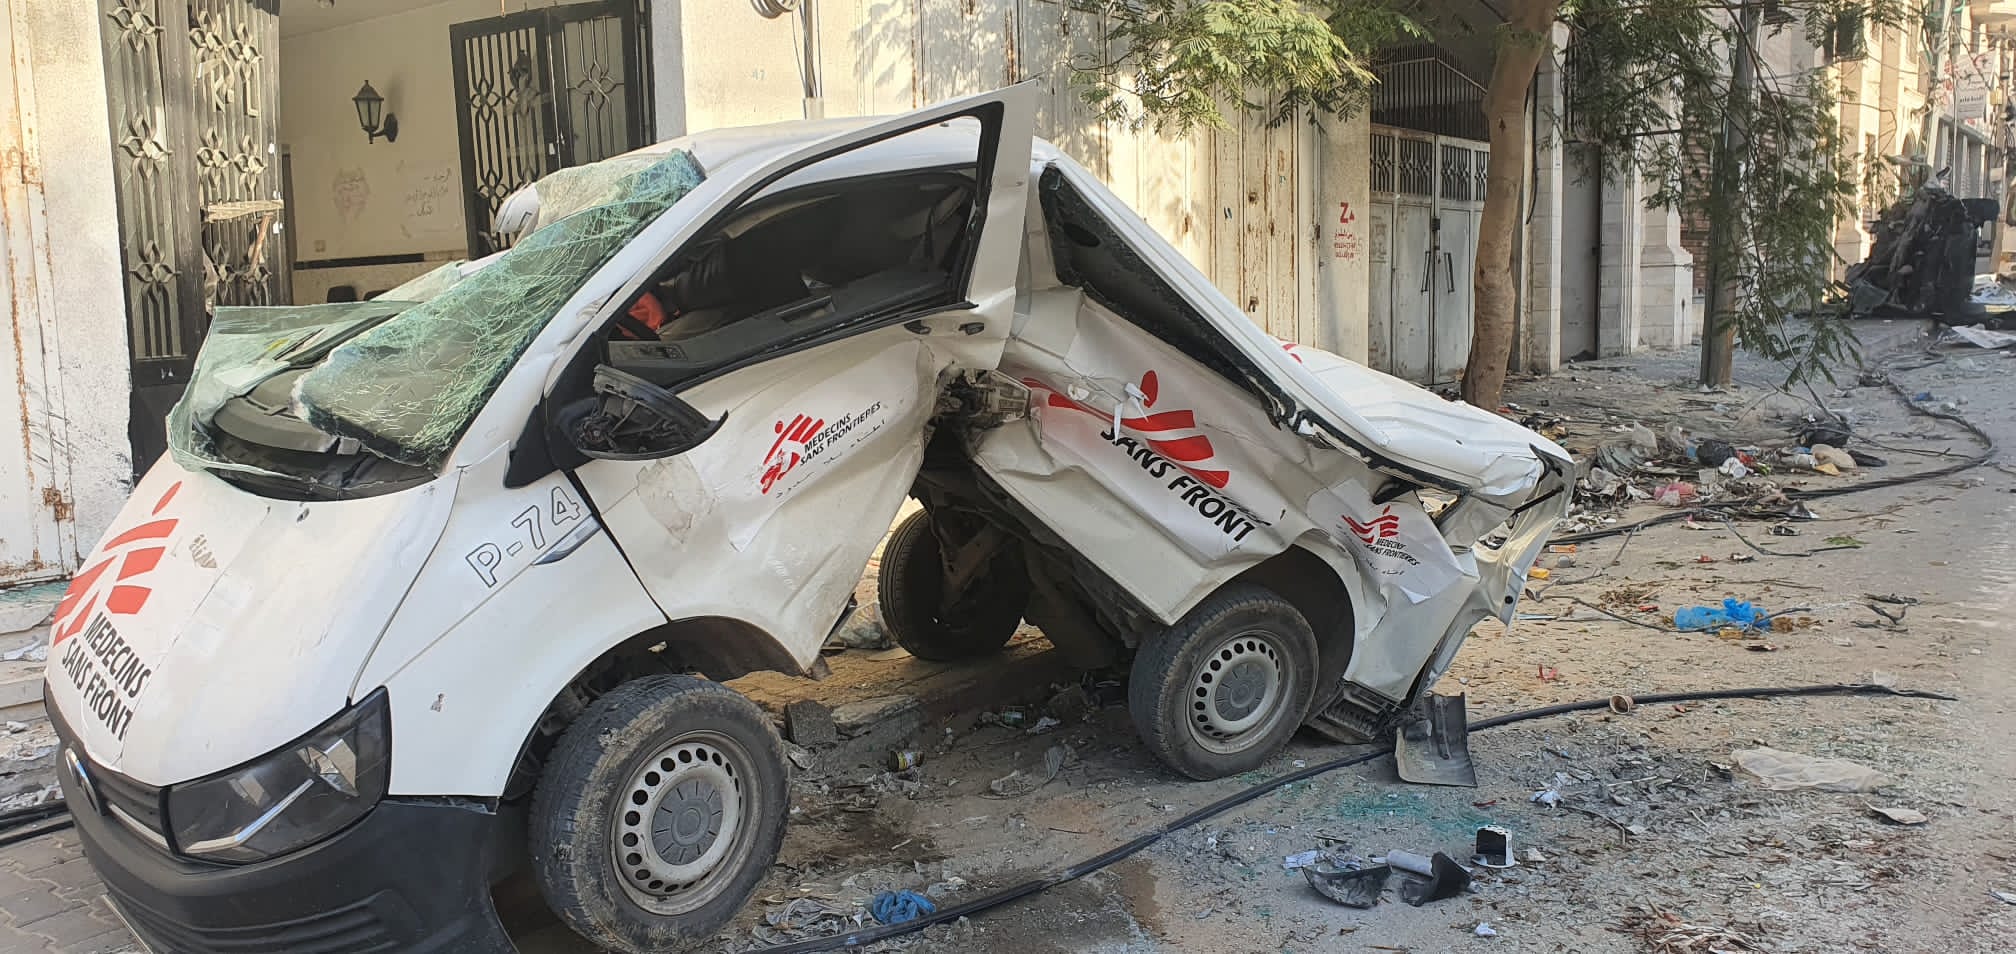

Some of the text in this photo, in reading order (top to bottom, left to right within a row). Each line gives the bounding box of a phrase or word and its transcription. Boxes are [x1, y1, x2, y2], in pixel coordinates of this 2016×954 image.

[800, 445, 825, 466] SANS
[804, 412, 852, 454] MEDECINS
[465, 486, 581, 588] P-74
[1167, 475, 1256, 542] FRONT
[62, 638, 134, 741] SANS FRONT
[83, 611, 152, 699] MEDECINS
